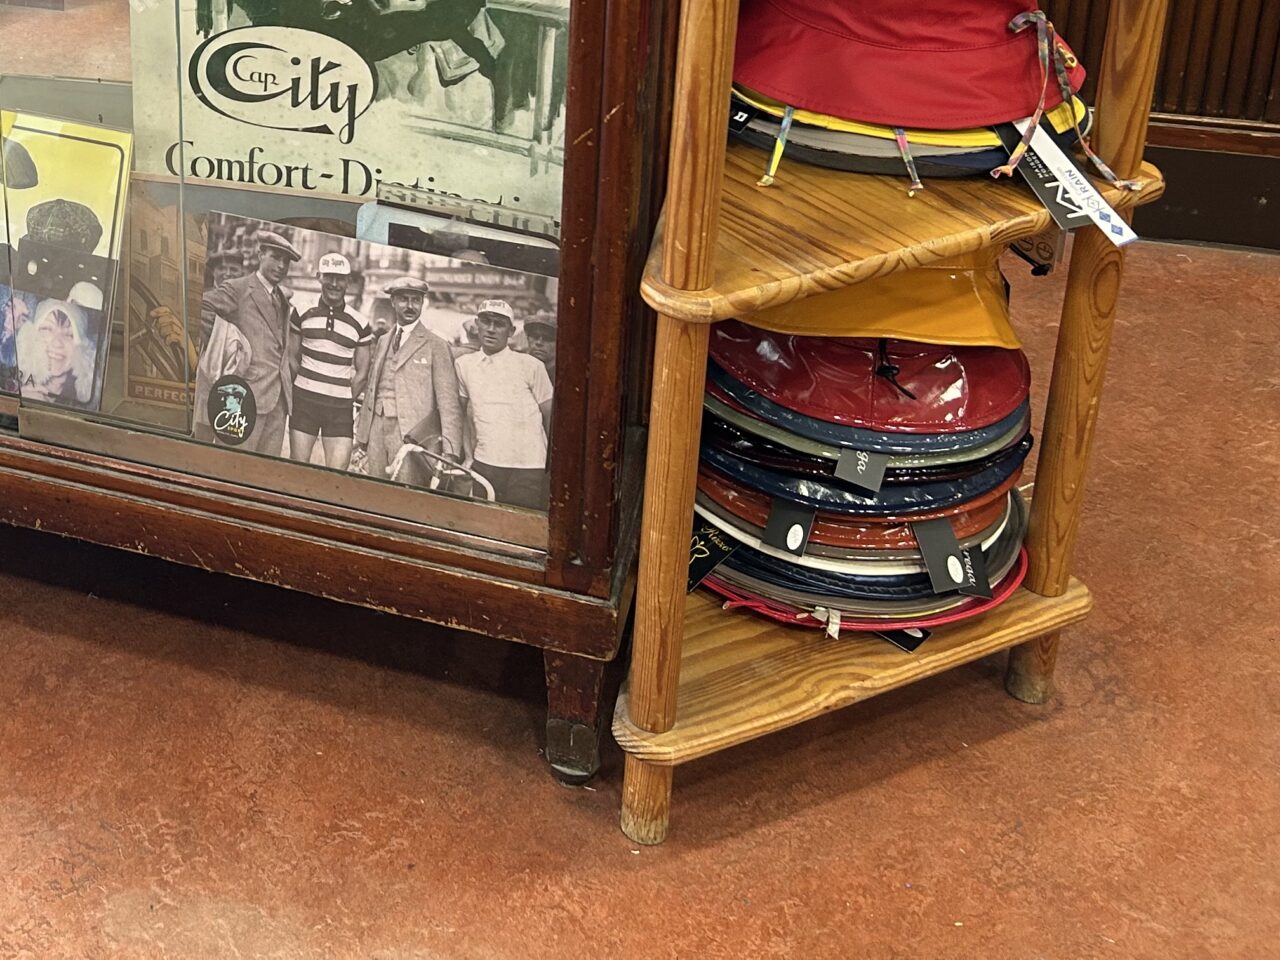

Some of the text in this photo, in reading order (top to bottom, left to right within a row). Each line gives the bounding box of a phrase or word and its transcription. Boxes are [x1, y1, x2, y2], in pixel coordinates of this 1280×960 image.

[206, 41, 359, 145] Cap City
[1065, 169, 1090, 194] RAIN
[213, 410, 249, 439] City
